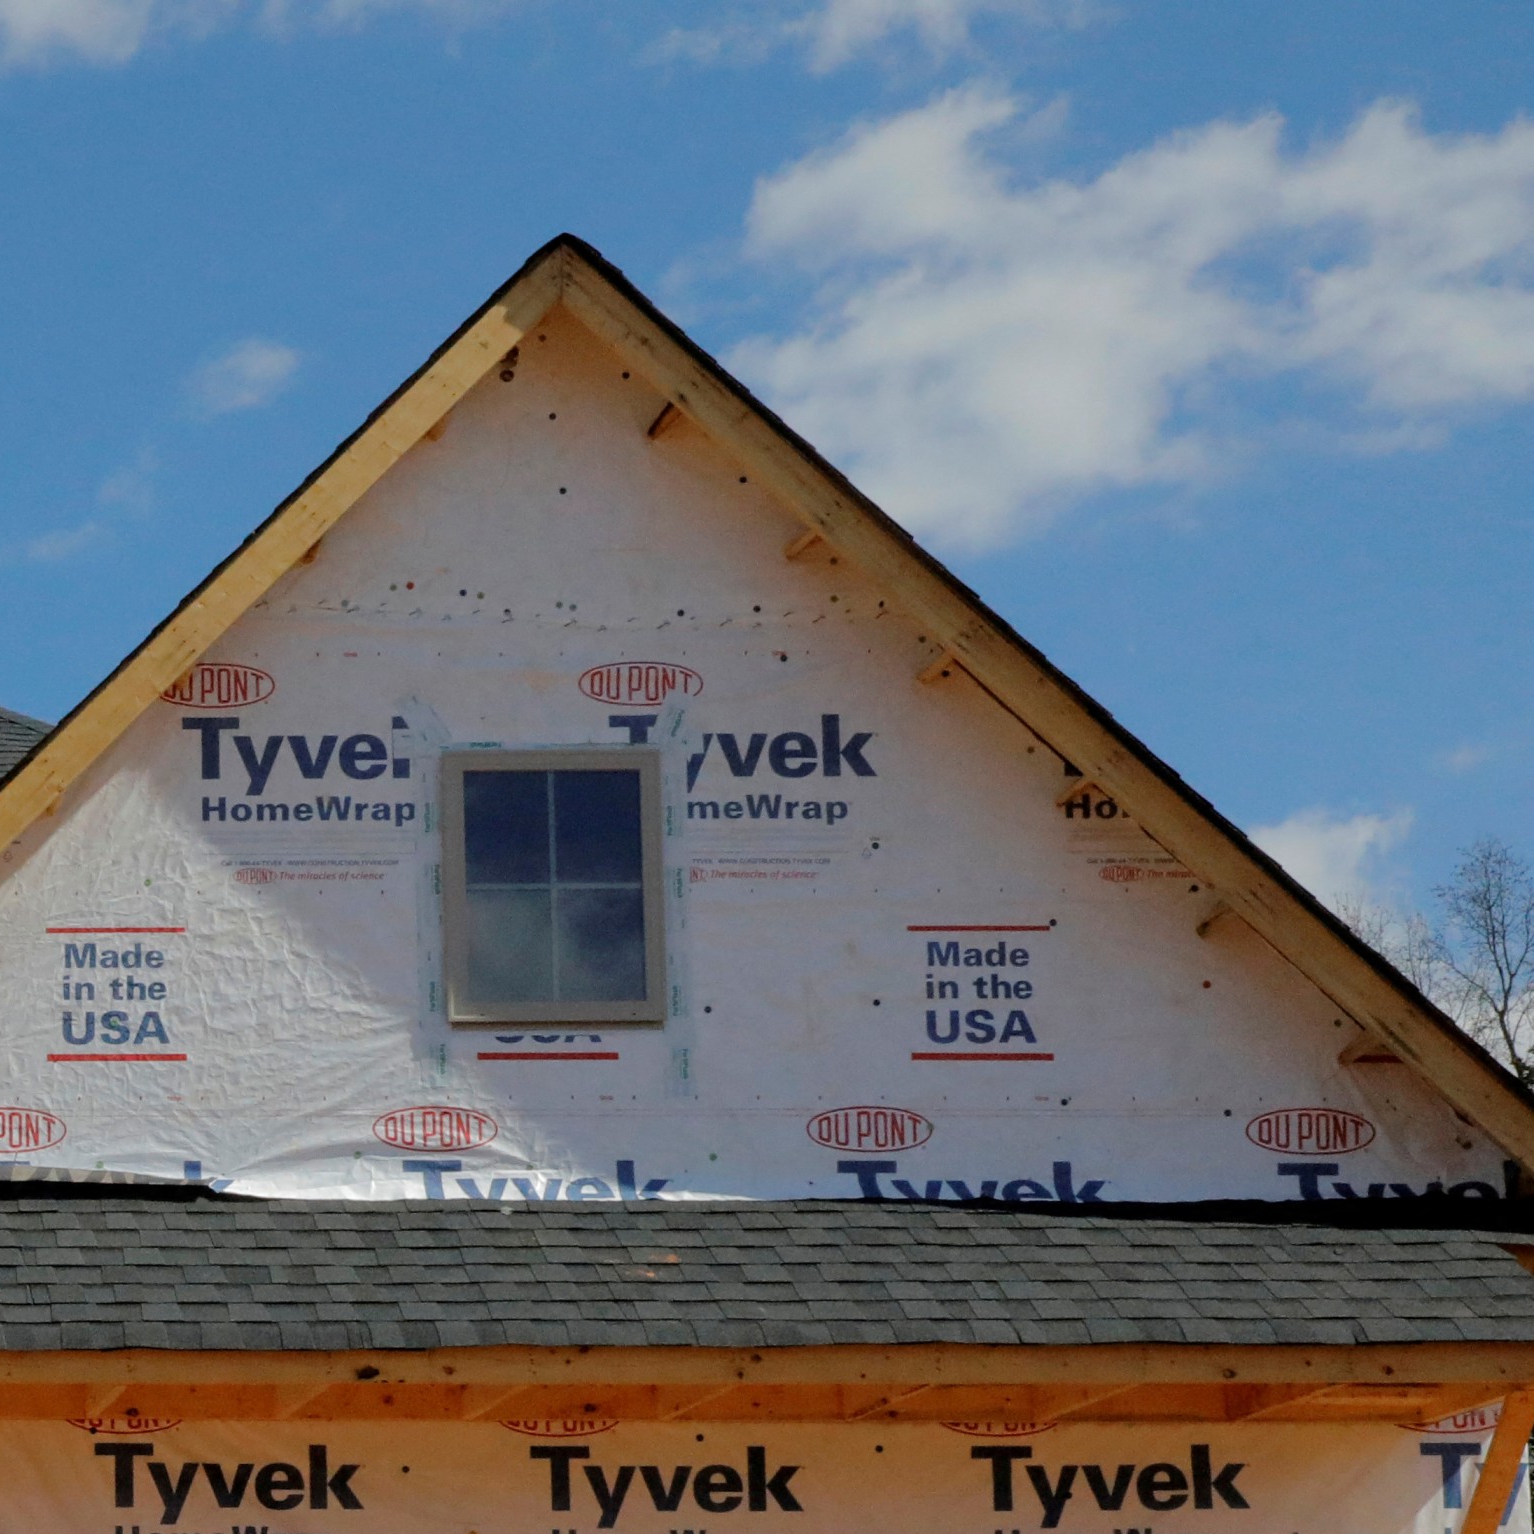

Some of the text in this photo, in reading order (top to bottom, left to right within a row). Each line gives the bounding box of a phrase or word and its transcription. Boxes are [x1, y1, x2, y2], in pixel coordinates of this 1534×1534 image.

[202, 796, 415, 827] HomeWrap
[63, 943, 165, 969] Made
[926, 941, 1030, 967] Made
[62, 976, 168, 1000] in the
[926, 973, 1032, 999] in the
[62, 1011, 171, 1045] USA
[926, 1010, 1038, 1044] USA
[94, 1442, 364, 1525] Tyvek
[531, 1445, 804, 1529] Tyvek
[971, 1444, 1251, 1529] Tyvek
